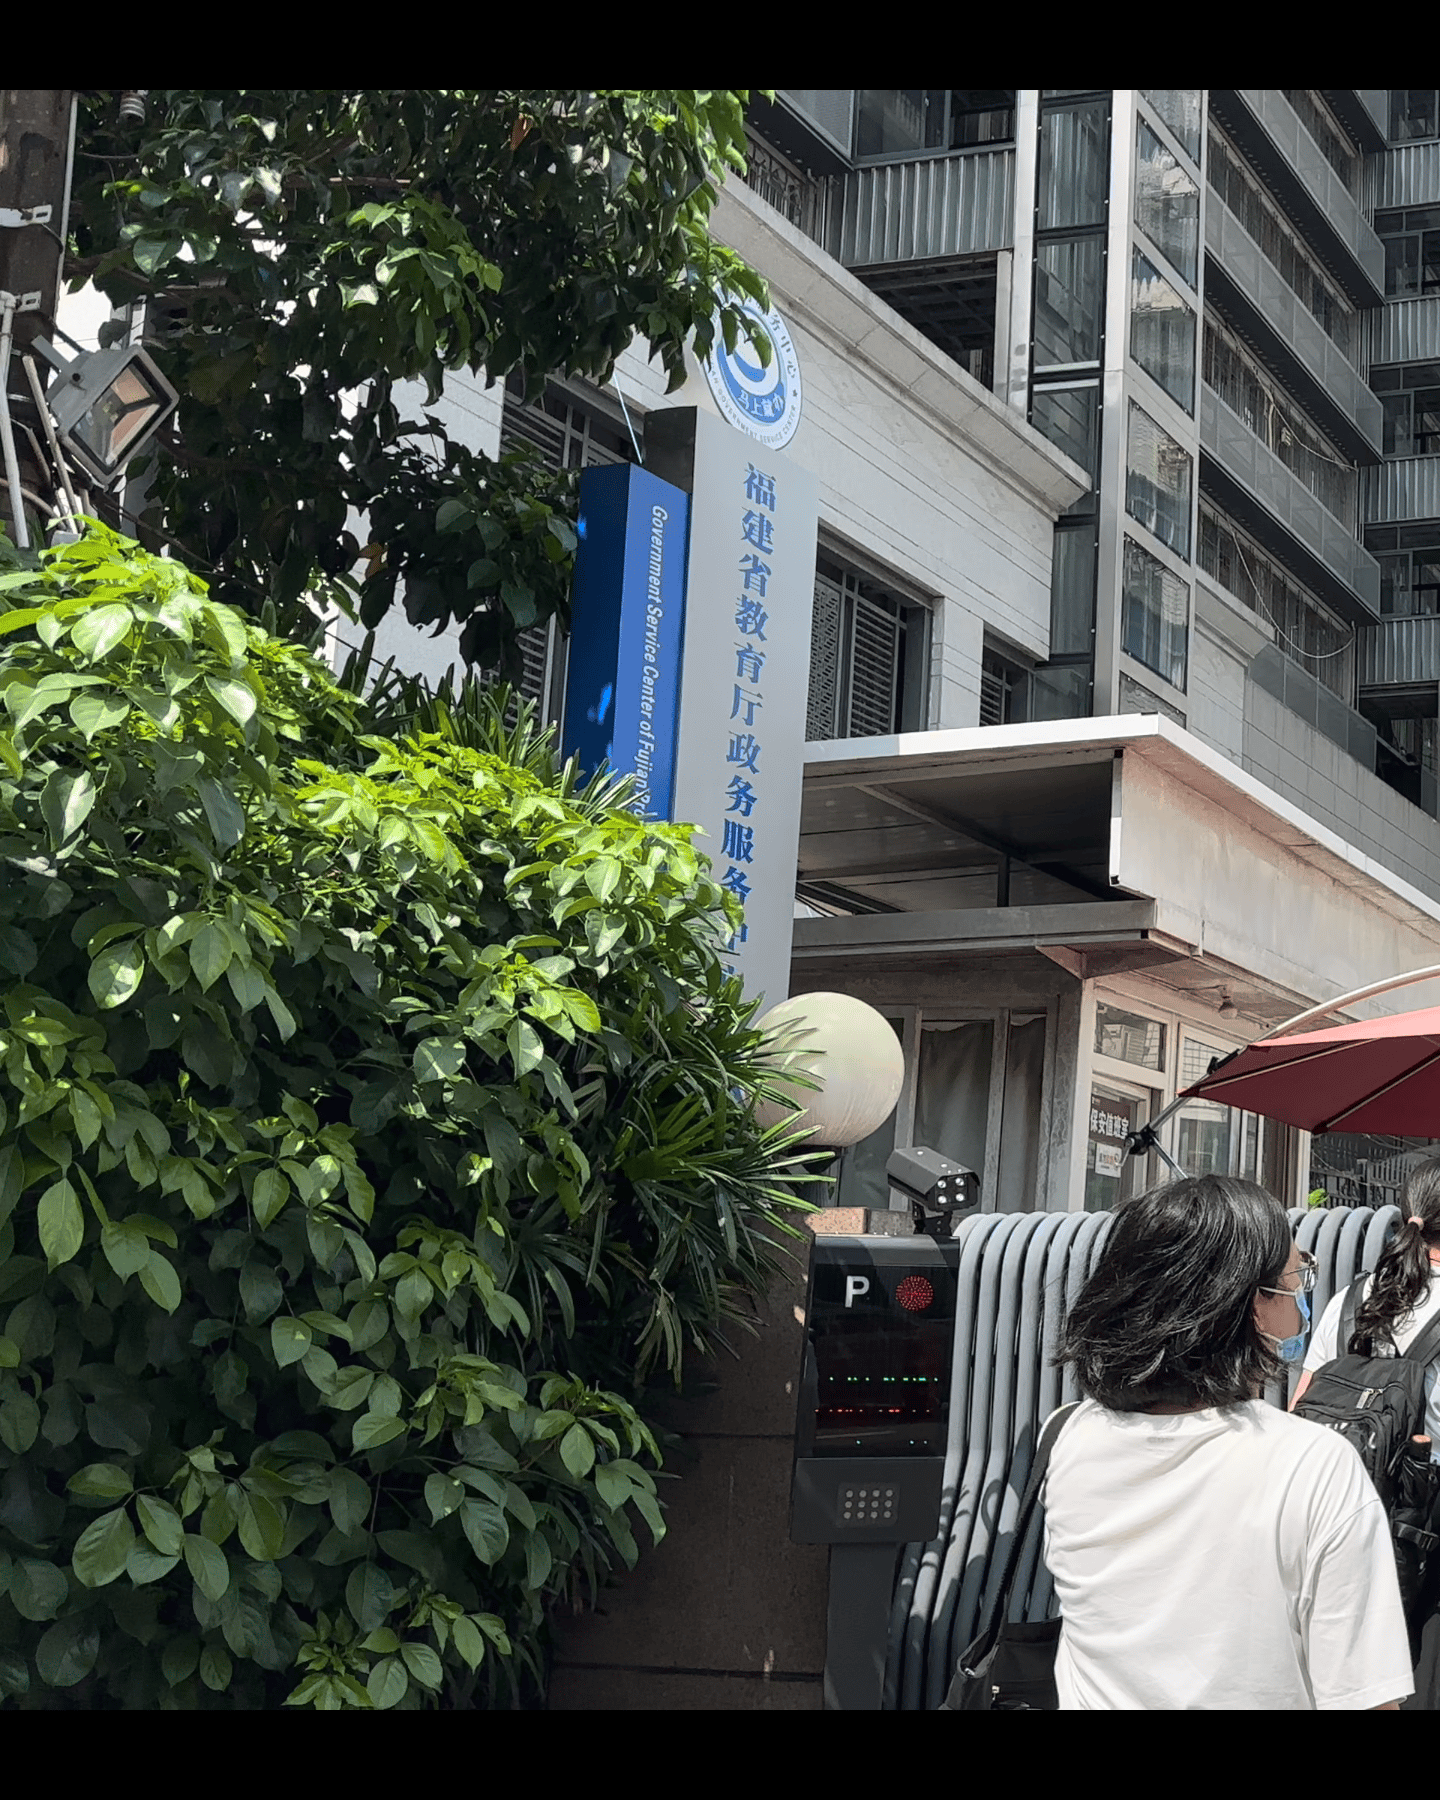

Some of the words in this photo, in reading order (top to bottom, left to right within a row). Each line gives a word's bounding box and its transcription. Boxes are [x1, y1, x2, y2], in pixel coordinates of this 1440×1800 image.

[647, 504, 669, 604] Government
[643, 603, 663, 664] Service
[640, 665, 660, 718] Center
[638, 719, 656, 741] of
[719, 460, 777, 985] 福建省教育厅政务服务
[633, 739, 655, 789] Fujian
[844, 1274, 870, 1309] P
